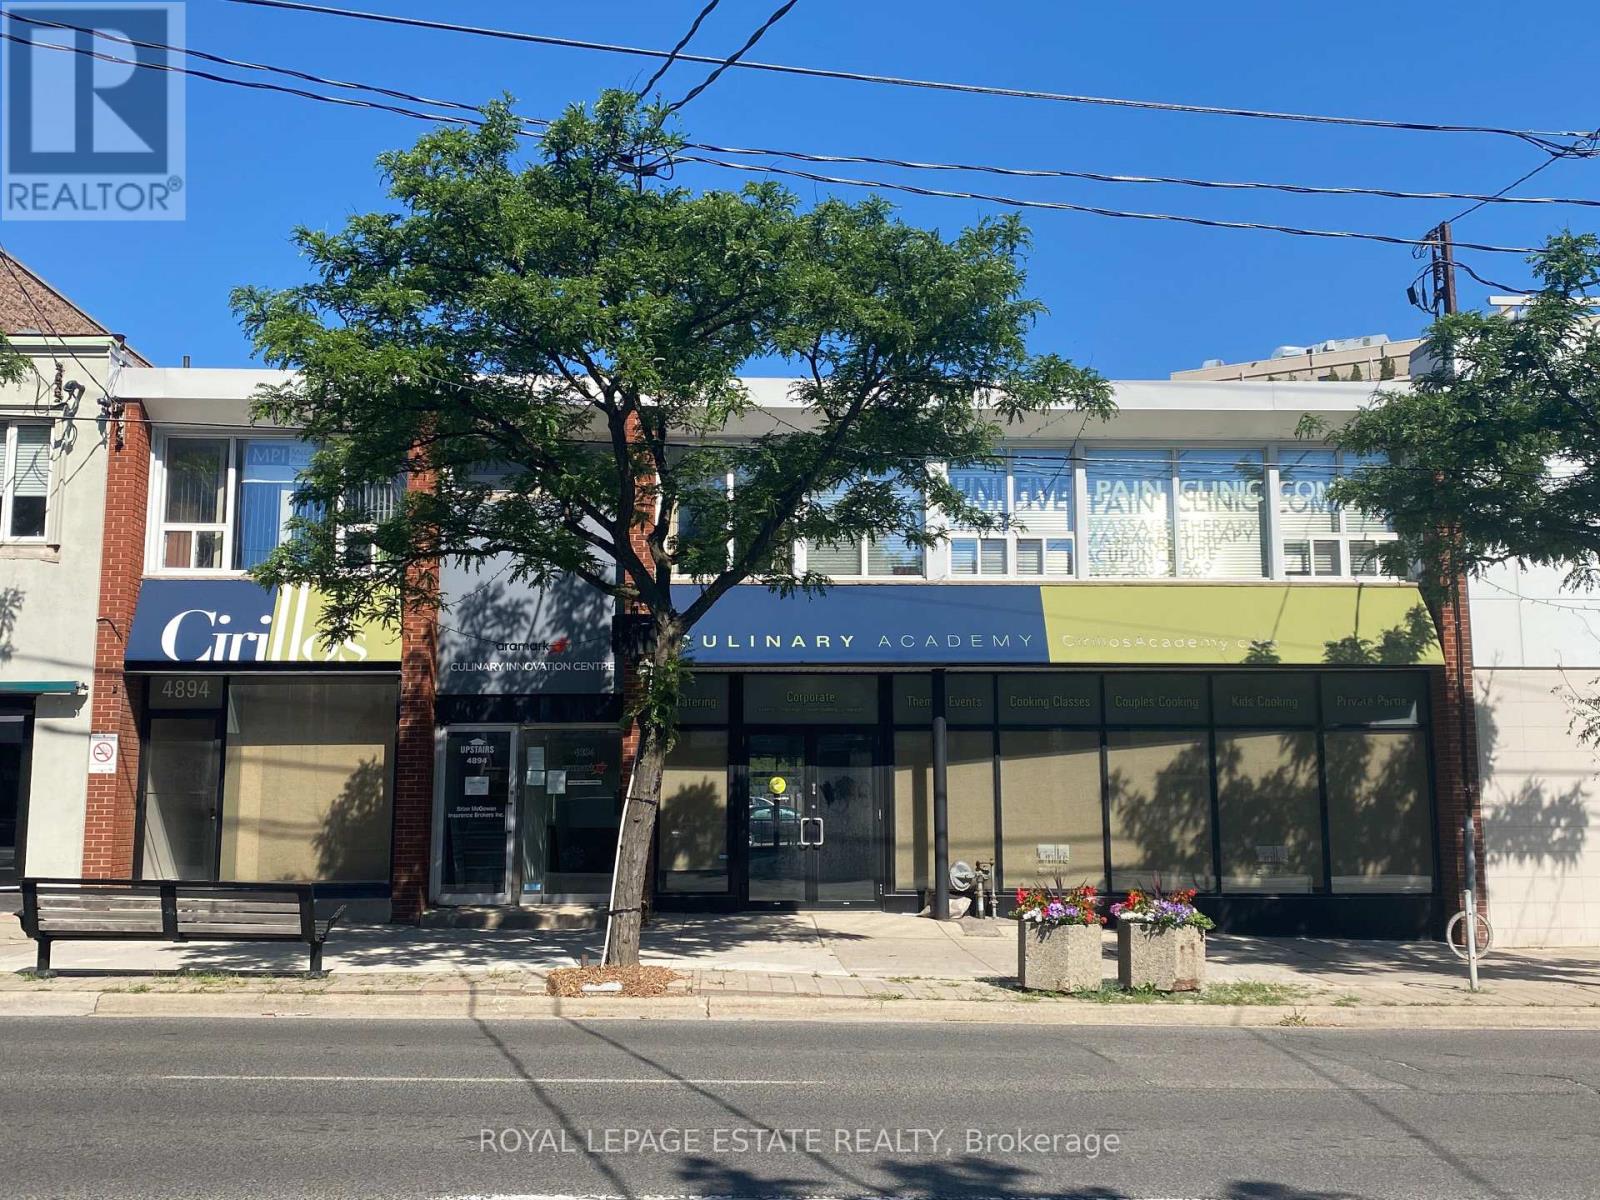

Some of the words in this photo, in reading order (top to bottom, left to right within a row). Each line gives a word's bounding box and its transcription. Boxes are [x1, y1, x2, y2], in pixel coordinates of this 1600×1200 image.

[1096, 480, 1163, 500] PAIN
[1179, 480, 1264, 502] CLINIC
[496, 638, 549, 651] aramark
[878, 634, 1034, 648] ACADEMY
[450, 661, 503, 672] CULINARY
[506, 661, 571, 671] INNOVATION
[573, 661, 615, 671] CENTRE
[161, 679, 210, 699] 4894
[786, 690, 836, 705] Corporate
[948, 695, 984, 708] Events
[1009, 695, 1049, 710] Cooking
[1052, 695, 1091, 708] Classes
[1115, 695, 1155, 710] Couples
[1158, 695, 1200, 710] Cooking
[1257, 695, 1299, 710] Cooking
[460, 745, 495, 754] UPSTAIRS
[466, 757, 488, 765] 4894
